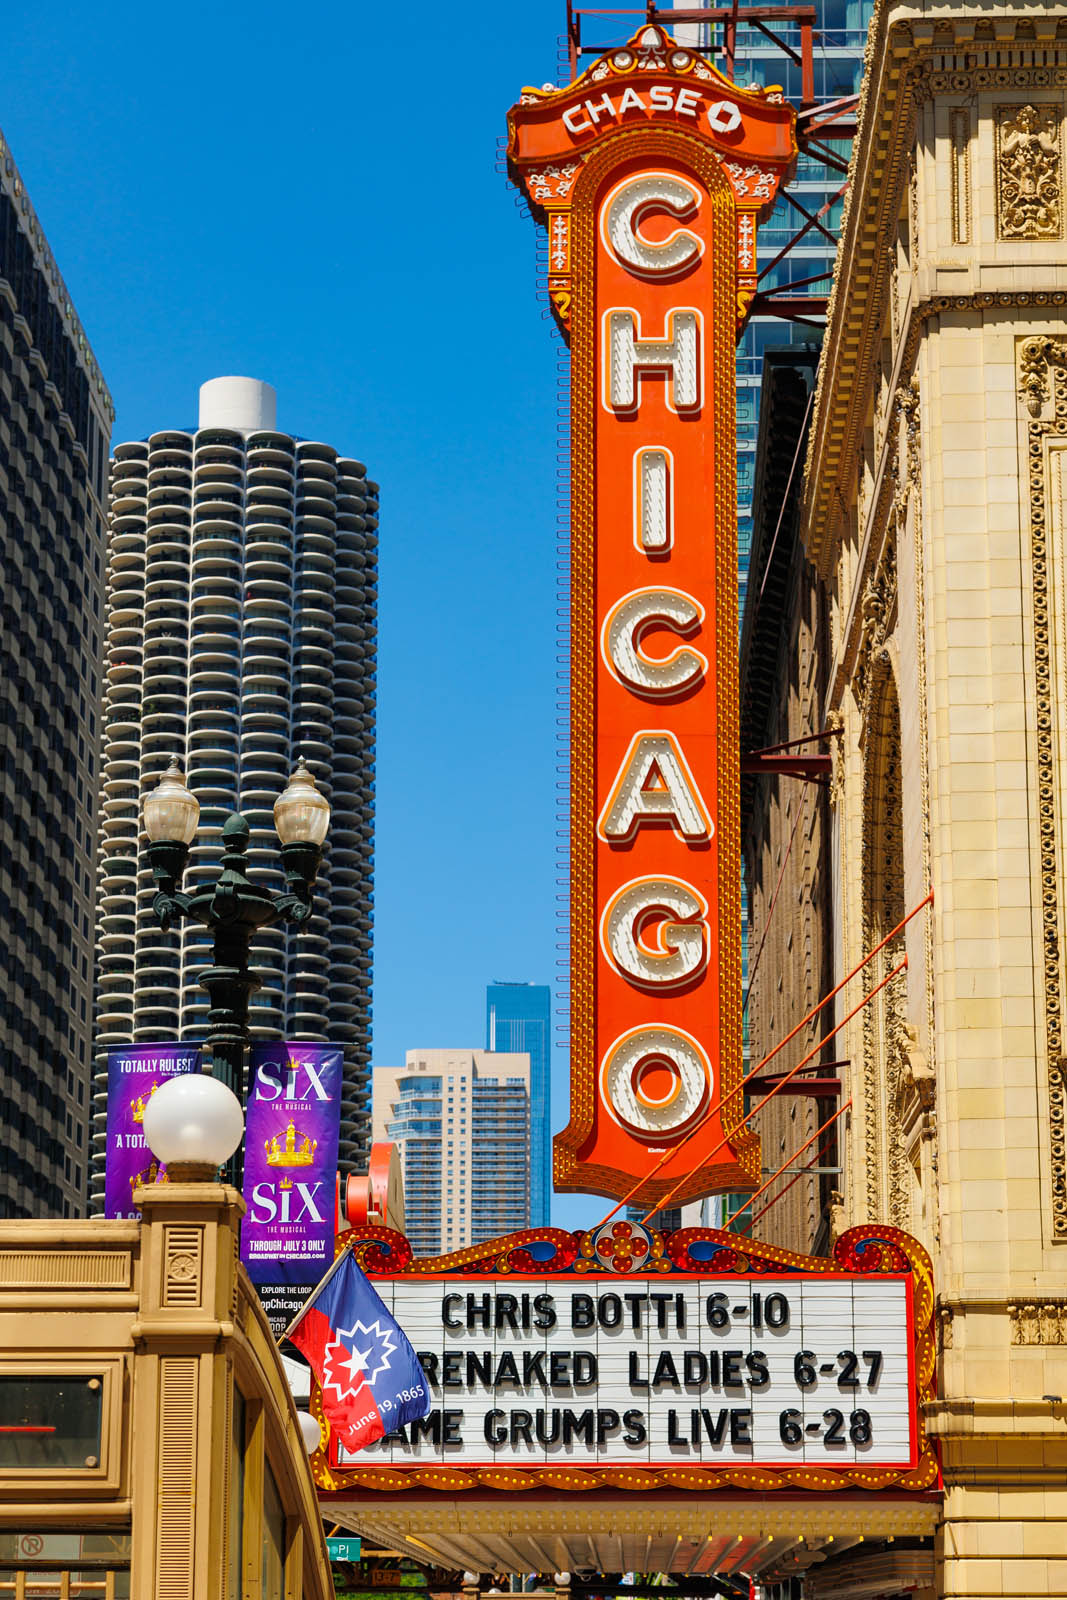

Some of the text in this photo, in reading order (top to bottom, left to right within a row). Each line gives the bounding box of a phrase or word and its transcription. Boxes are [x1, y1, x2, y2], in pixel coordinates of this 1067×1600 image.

[561, 85, 703, 134] CHASE
[596, 171, 715, 1139] CHICAGO
[271, 1103, 312, 1111] THE MUSICAL
[249, 1240, 326, 1252] THROUGH JULY 3 ONLY
[267, 1226, 307, 1234] THE MUSICAL
[261, 1286, 313, 1294] EXPLORE THE LOOP
[441, 1292, 791, 1330] CHRIS BOTTI 6-10
[628, 1350, 770, 1388] LADIES
[794, 1350, 883, 1388] 6-27
[348, 1384, 425, 1436] June 19, 1865
[370, 1408, 873, 1447] AME GRUMPS LIVE 6-28
